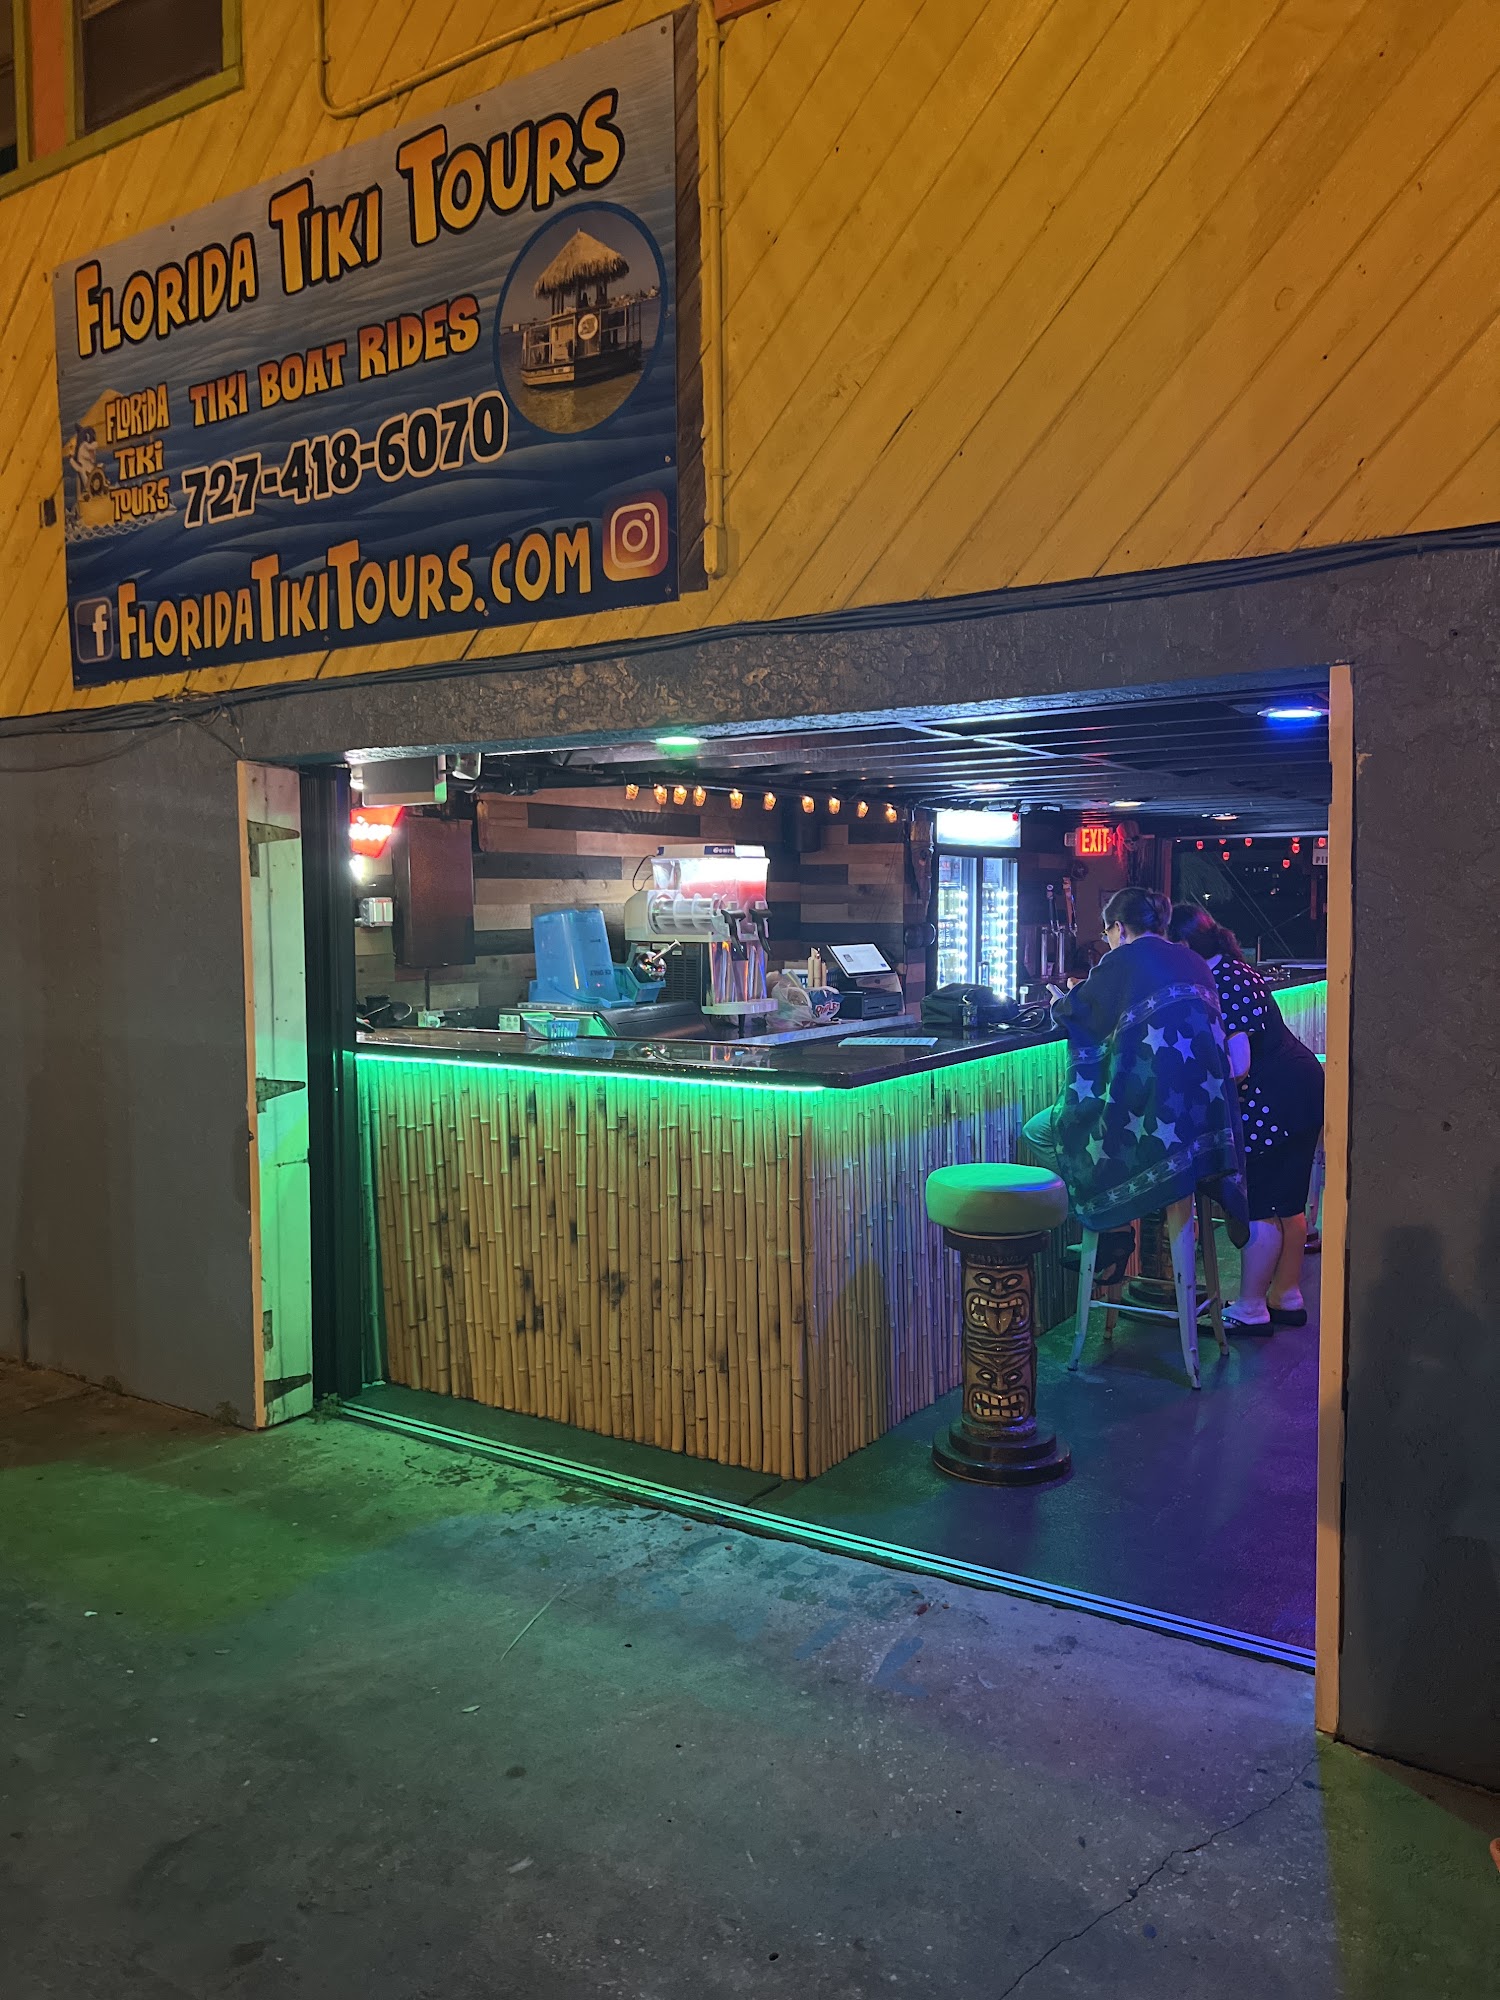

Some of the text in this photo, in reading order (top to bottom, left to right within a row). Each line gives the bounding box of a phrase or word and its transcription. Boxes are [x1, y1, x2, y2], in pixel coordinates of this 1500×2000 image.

[75, 89, 624, 358] FLORIDA TIKI TOURS
[189, 294, 480, 427] TIKI BOAT RIDES
[110, 477, 171, 522] TOURS
[181, 390, 508, 529] 727-418-6070
[1081, 828, 1109, 852] EXIT
